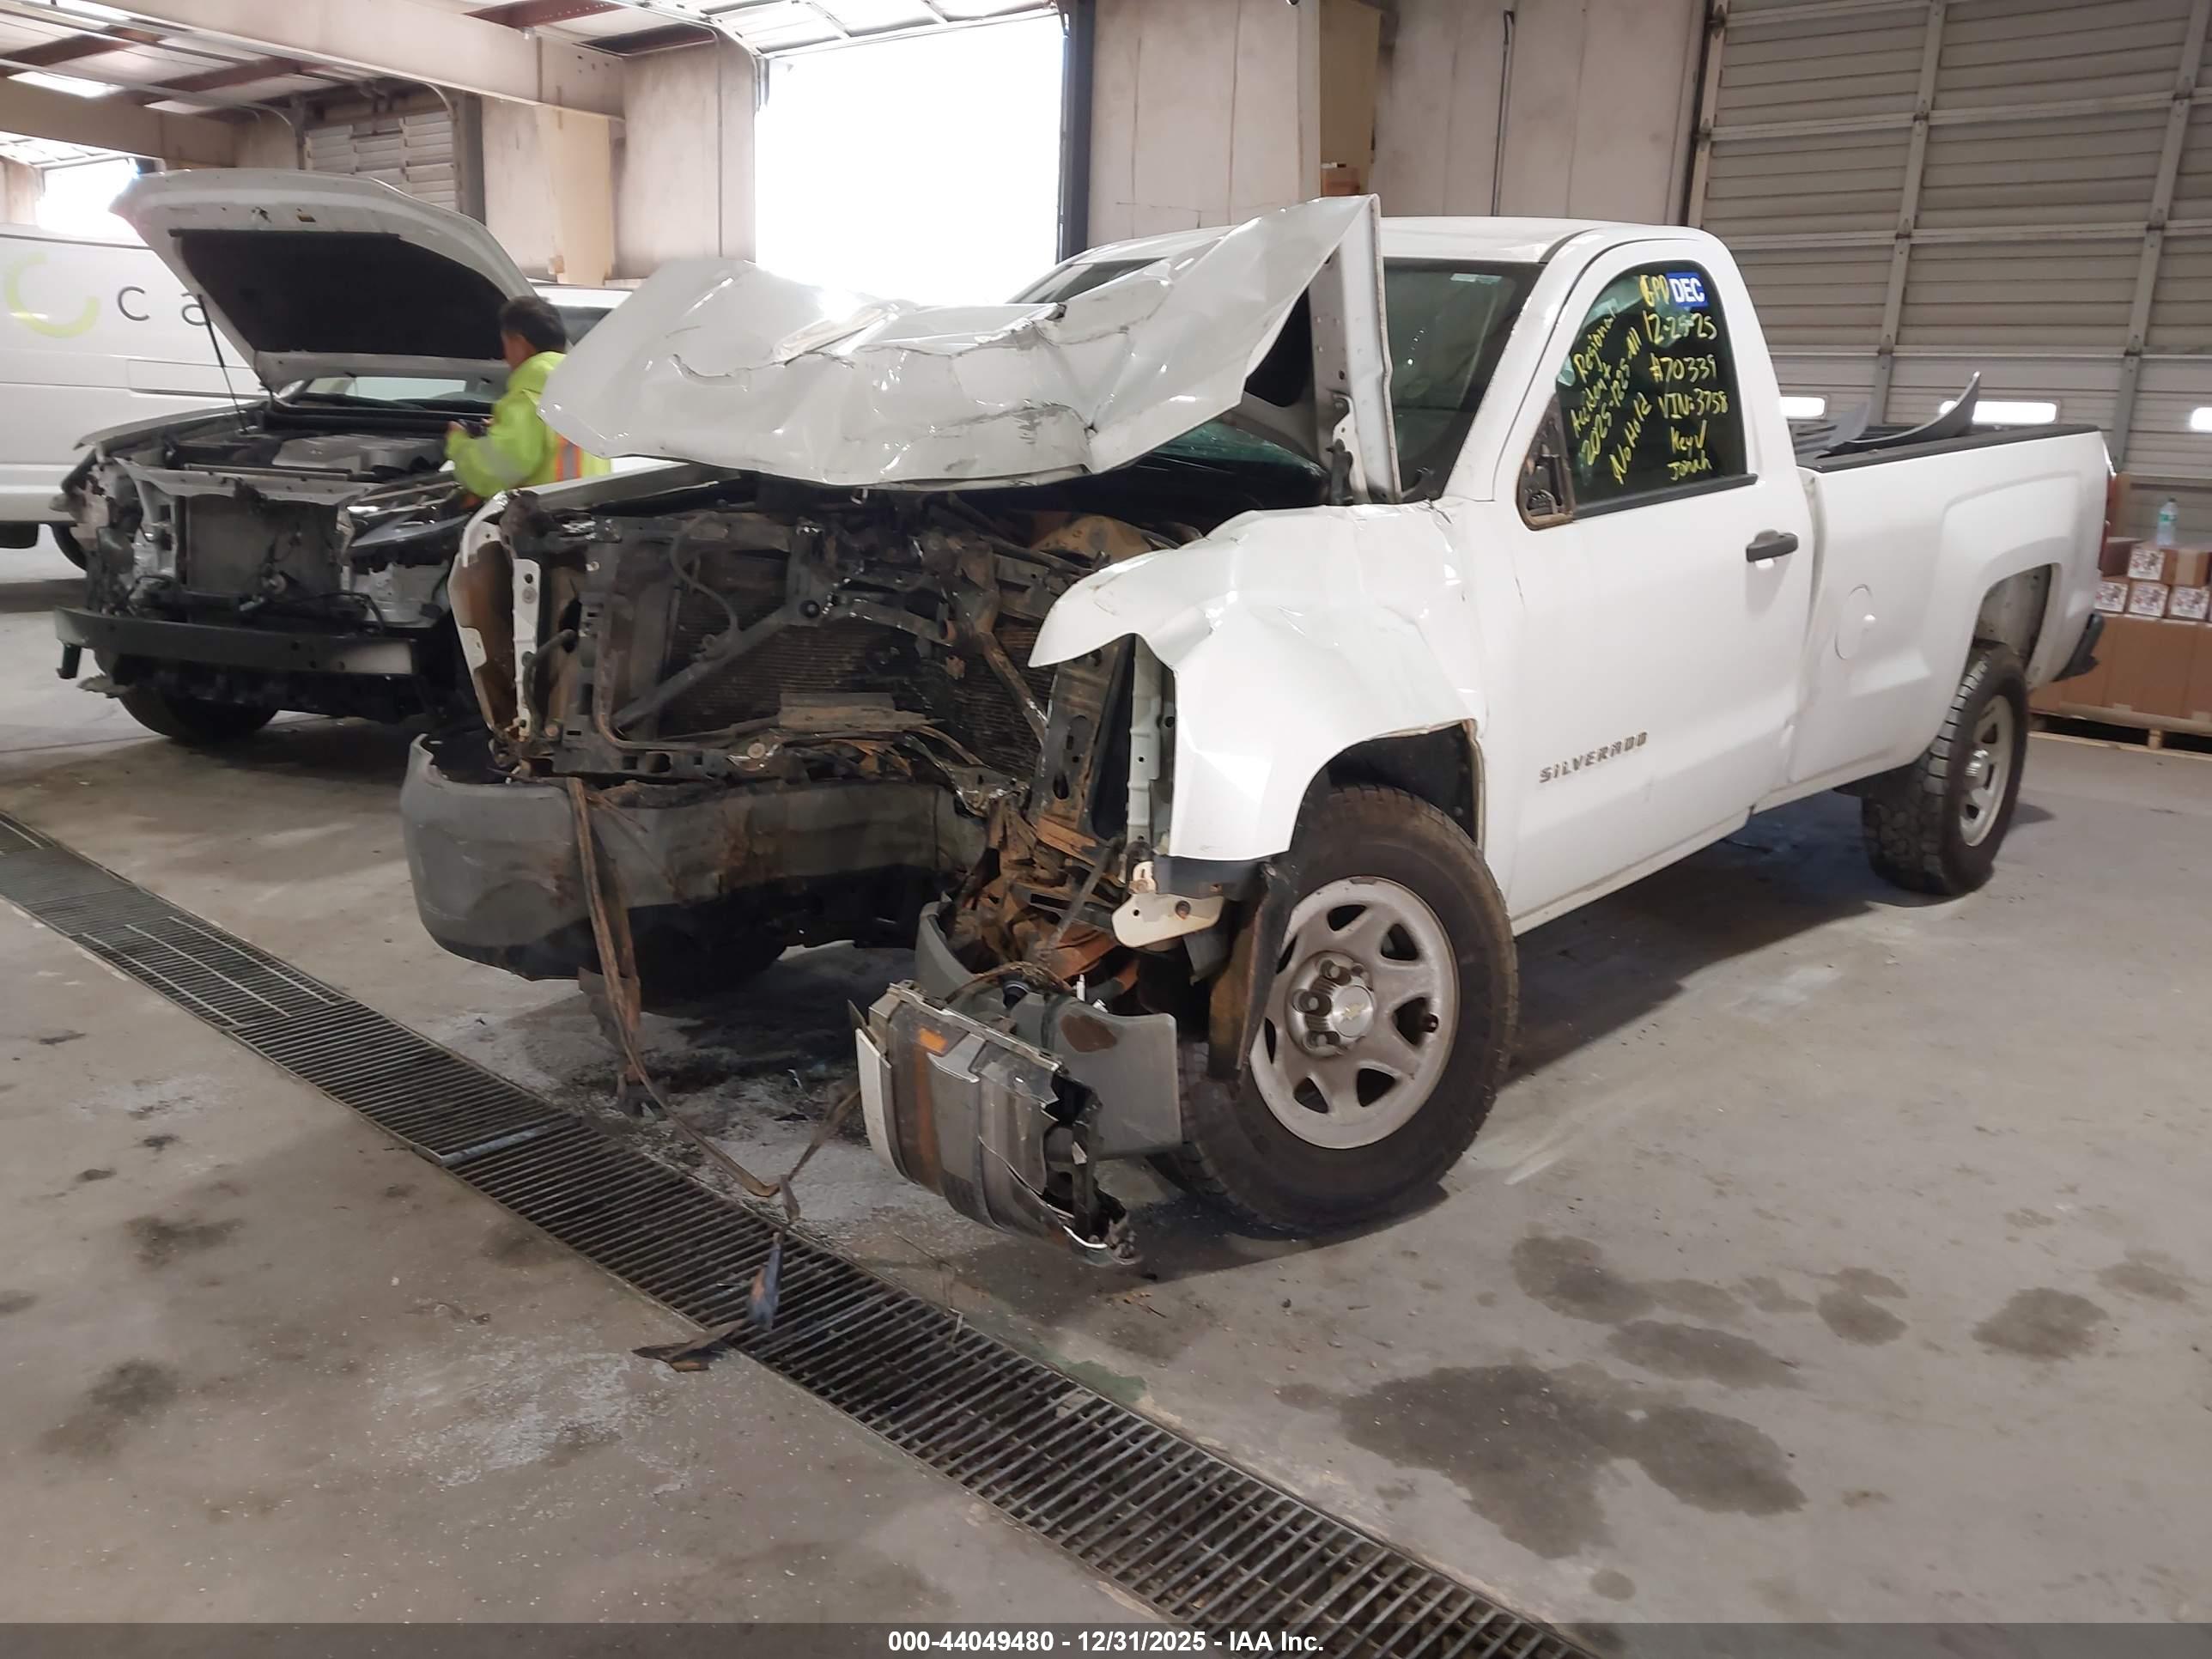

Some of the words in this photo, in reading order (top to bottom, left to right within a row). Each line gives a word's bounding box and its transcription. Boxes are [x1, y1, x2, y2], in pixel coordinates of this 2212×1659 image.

[1668, 276, 1705, 303] DEC
[1642, 309, 1718, 345] 12-25-25
[1539, 731, 1649, 784] SILVERADO
